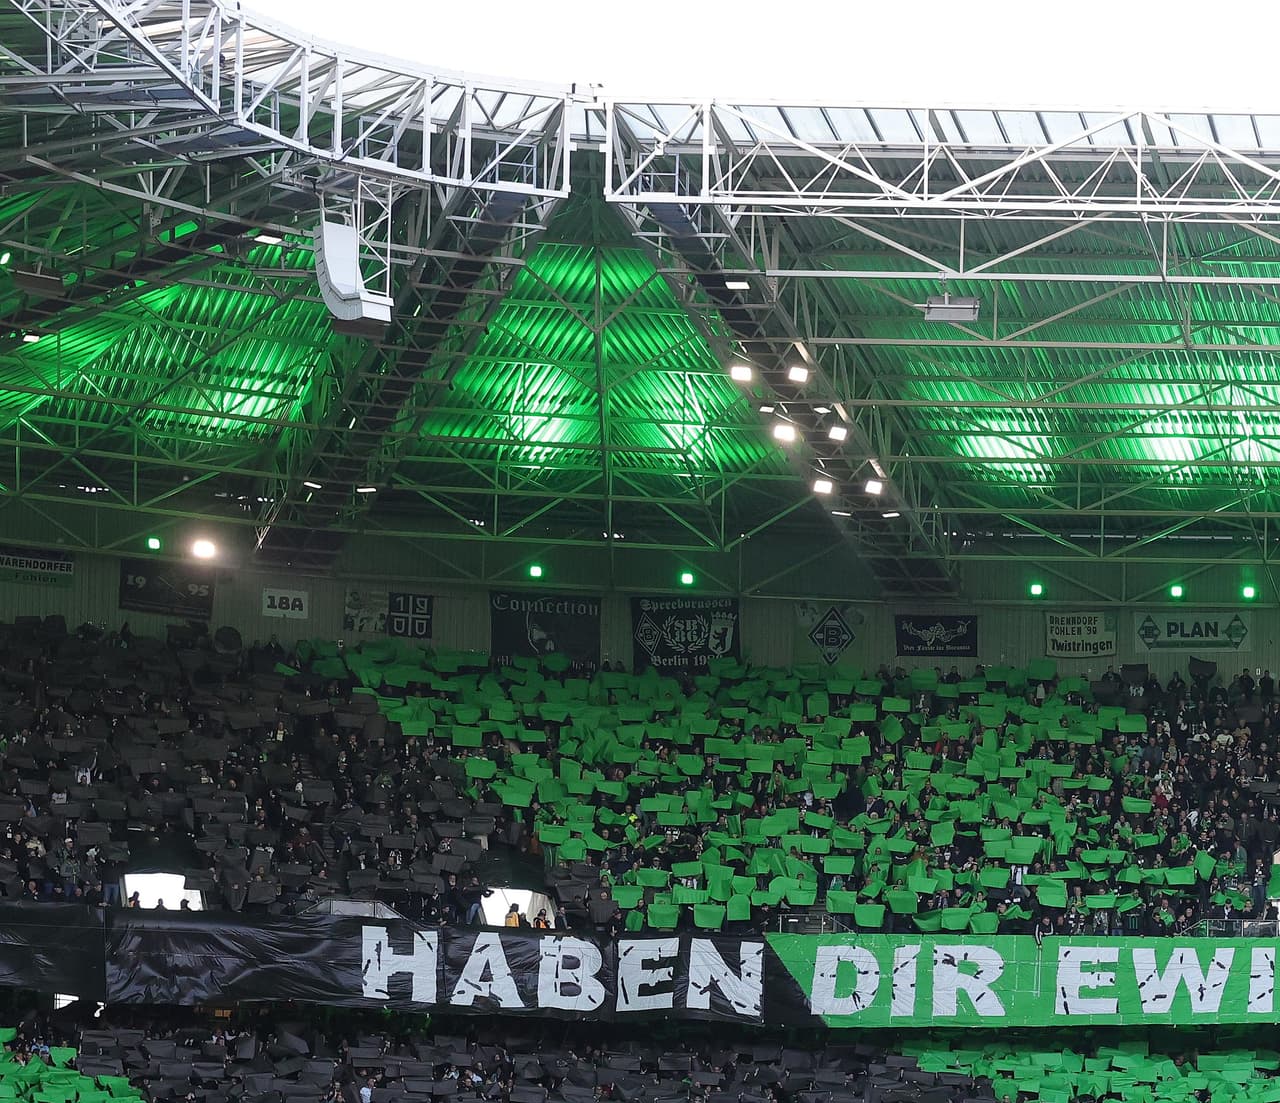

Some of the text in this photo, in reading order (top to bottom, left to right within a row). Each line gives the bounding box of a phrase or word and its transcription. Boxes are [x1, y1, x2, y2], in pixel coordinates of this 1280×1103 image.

[127, 574, 209, 598] 19 95
[267, 595, 304, 612] 18A
[493, 593, 598, 616] Connection
[1167, 622, 1219, 638] PLAN
[1051, 639, 1112, 655] Twistringen
[650, 655, 722, 667] Berlin 19
[362, 926, 764, 1017] HABEN
[811, 943, 1005, 1018] DIR
